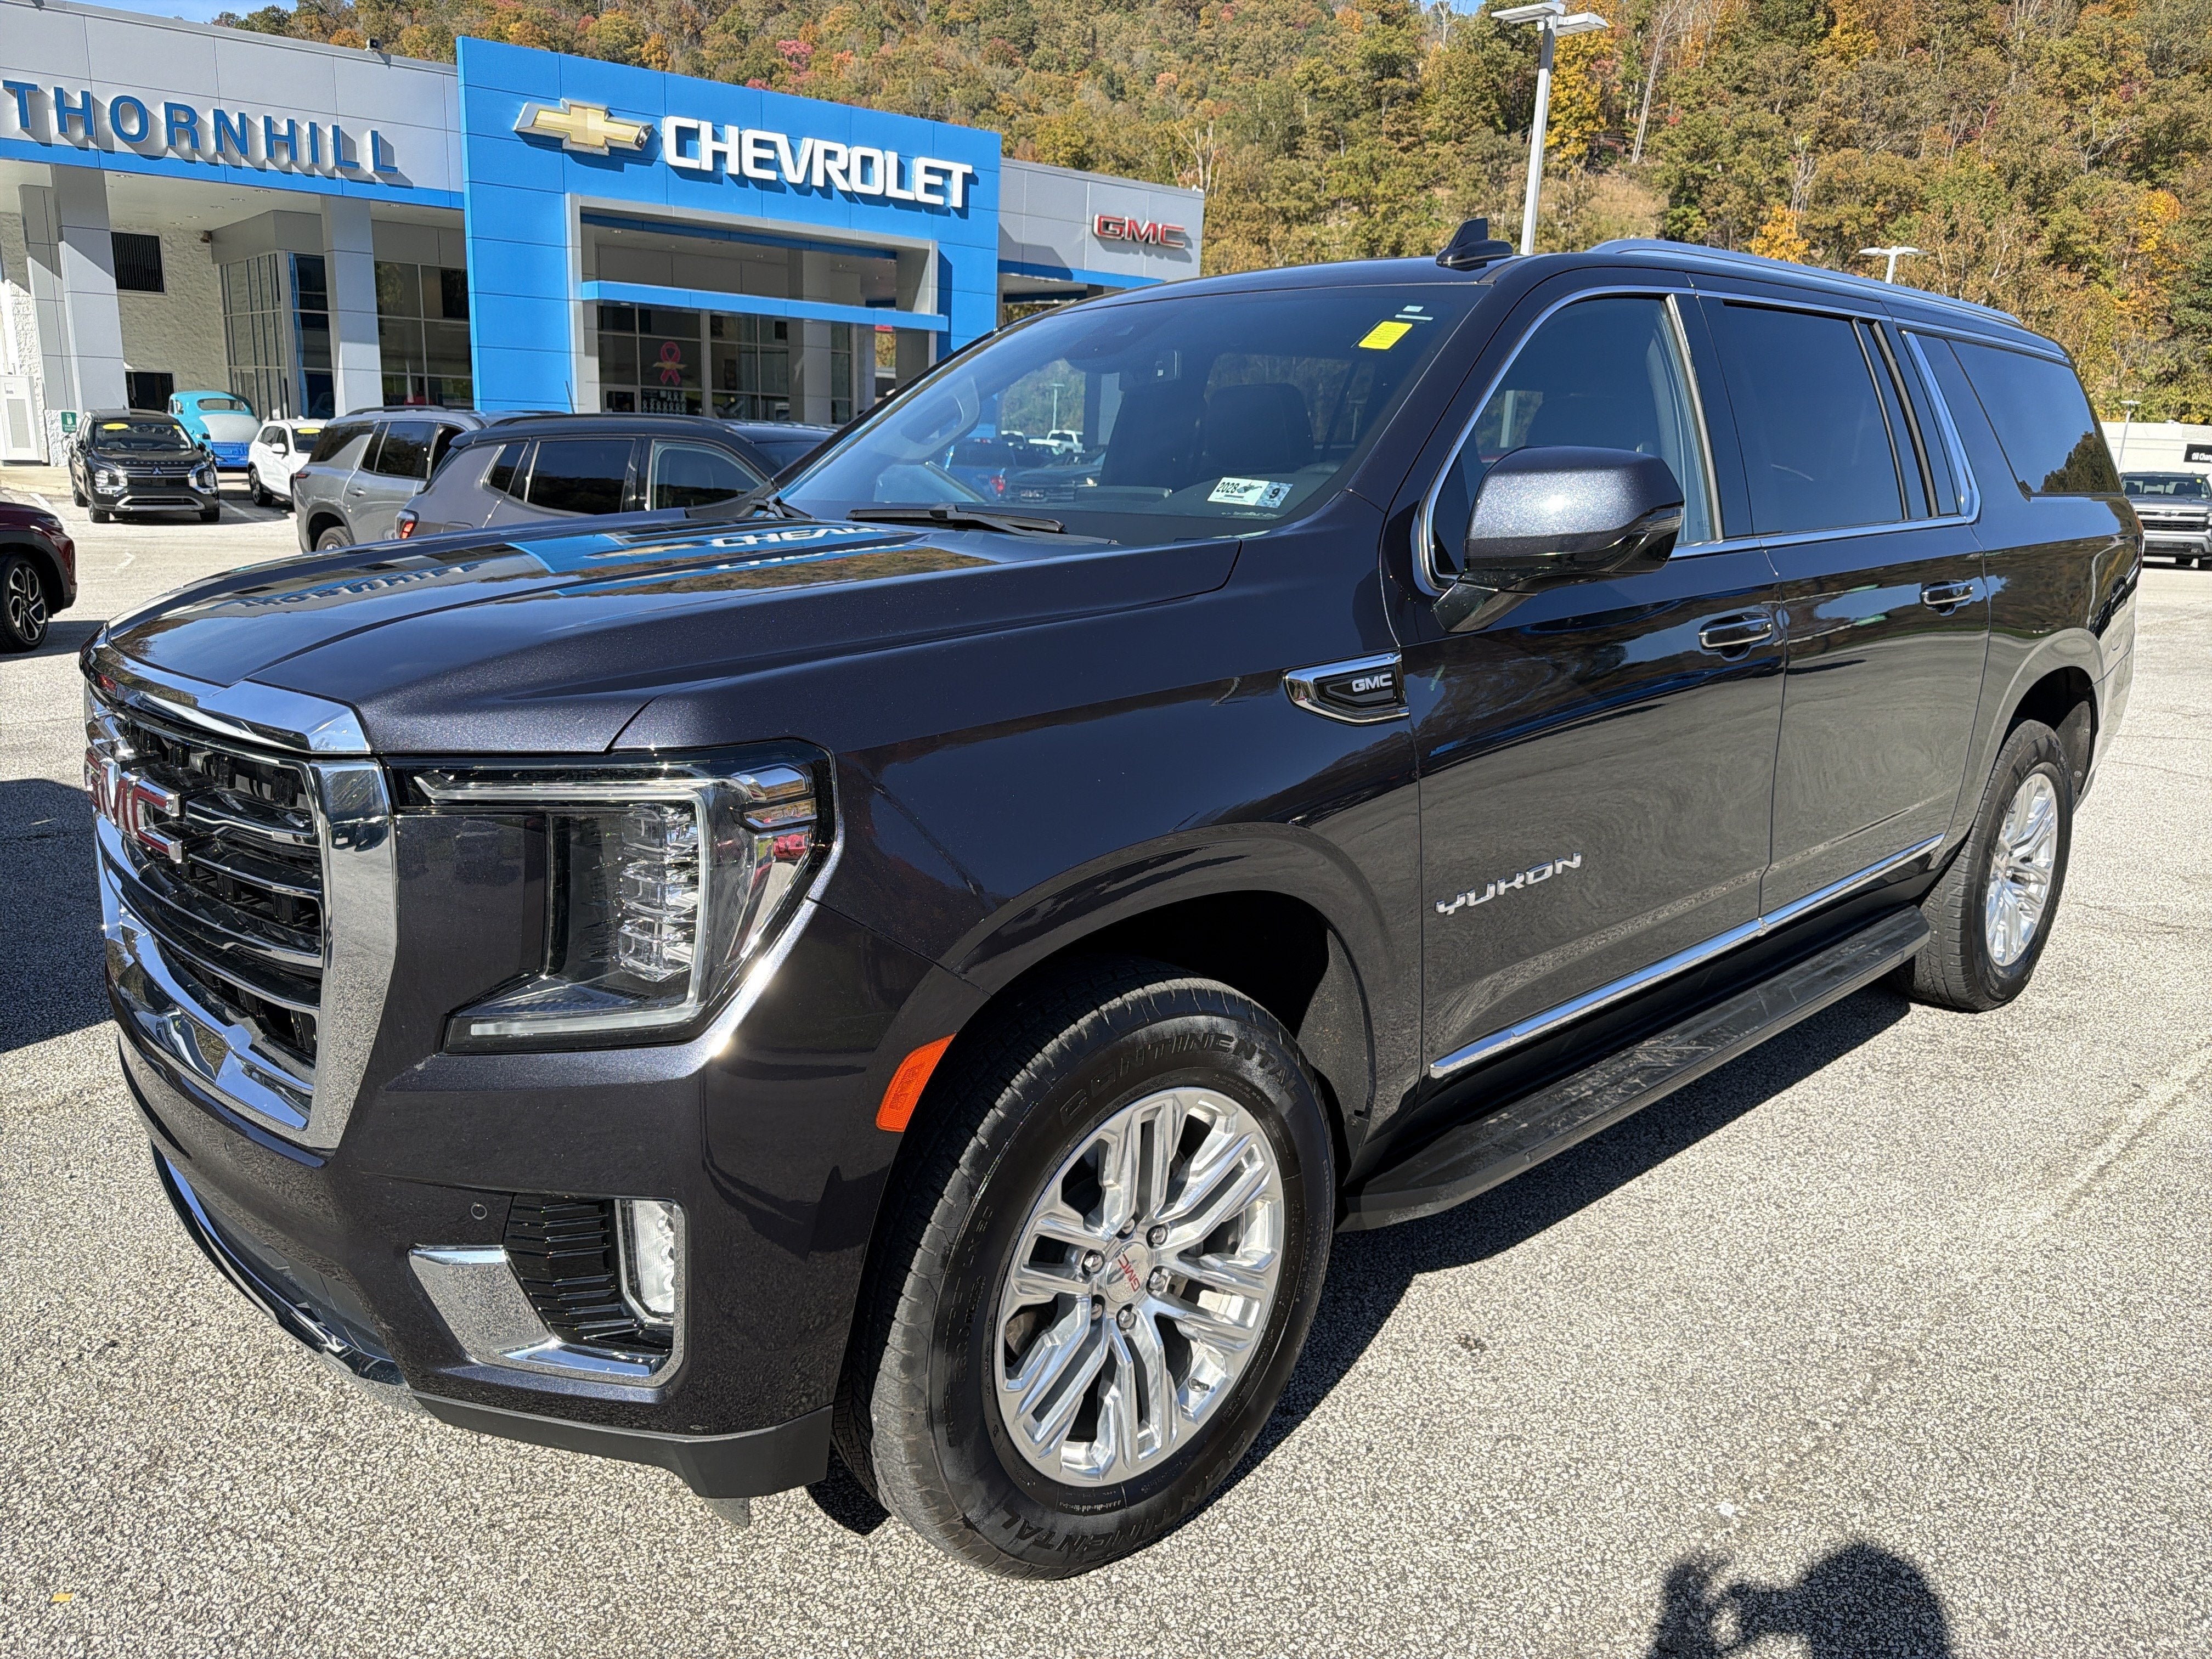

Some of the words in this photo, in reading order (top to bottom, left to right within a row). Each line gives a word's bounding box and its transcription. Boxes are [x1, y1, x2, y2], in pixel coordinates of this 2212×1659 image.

[2, 80, 398, 174] THORNHILL
[662, 116, 972, 208] CHEVROLET
[1094, 214, 1186, 249] GMC
[1216, 482, 1240, 494] 2028
[1269, 488, 1280, 499] 9
[1352, 673, 1393, 692] GMC
[86, 745, 182, 864] GMC
[1436, 852, 1582, 916] YUKON
[1059, 1032, 1298, 1127] CONTINENTAL
[1118, 1253, 1141, 1293] GMC
